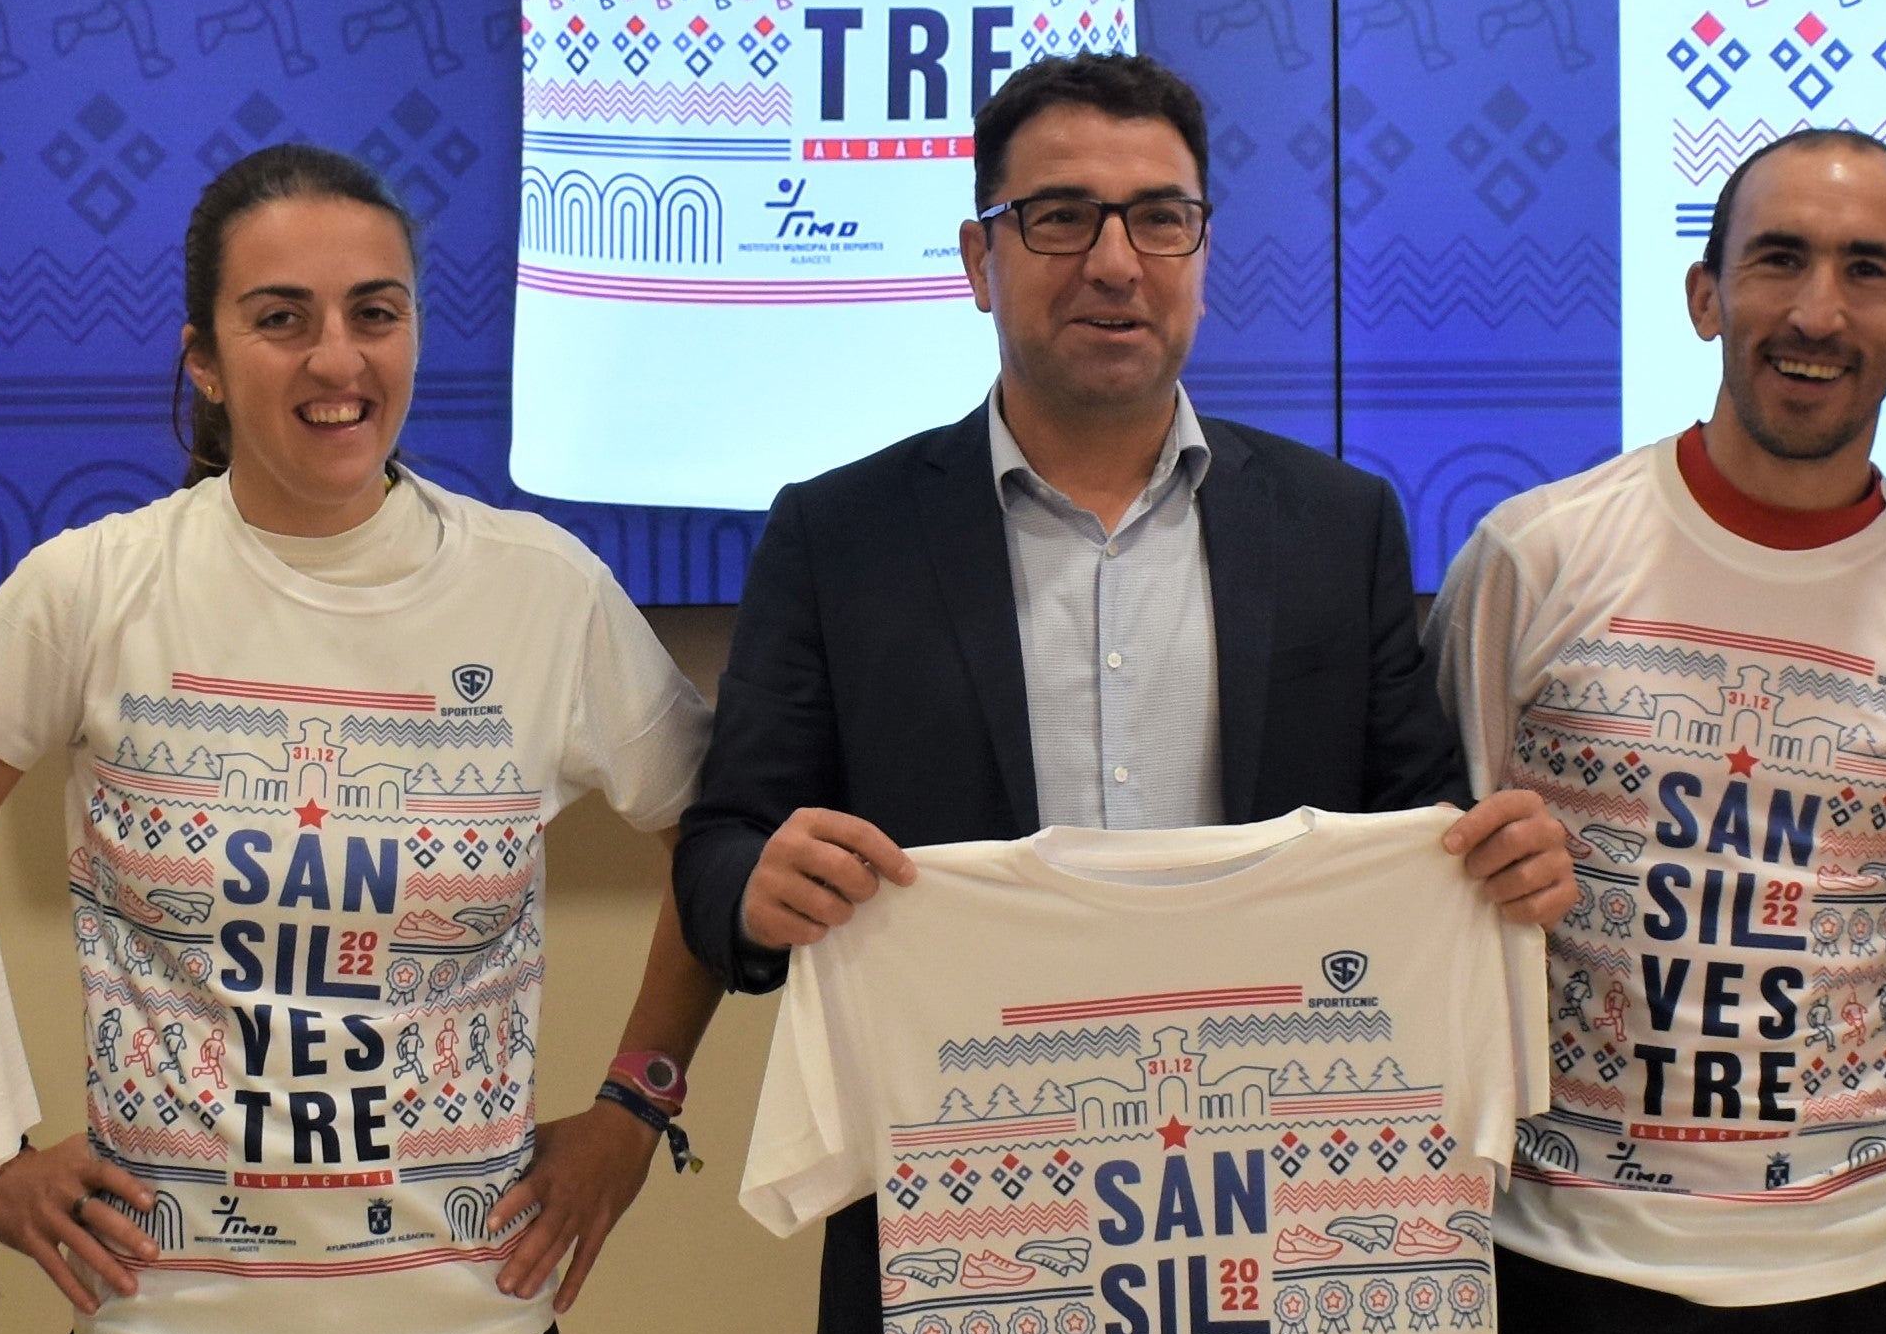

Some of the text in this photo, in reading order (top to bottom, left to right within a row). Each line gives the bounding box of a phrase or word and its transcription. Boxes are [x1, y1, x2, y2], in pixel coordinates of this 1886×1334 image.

[805, 5, 1013, 123] TRE
[814, 140, 957, 158] ALBACE
[440, 705, 503, 717] SPORTECNIC
[1727, 690, 1771, 711] 31.12
[293, 745, 335, 763] 31.12
[1655, 771, 1822, 867] SAN
[223, 828, 399, 914] SAN
[1764, 880, 1803, 902] 20
[1643, 863, 1807, 952] SIL
[1762, 904, 1799, 927] 22
[339, 930, 378, 952] 20
[219, 919, 381, 1000] SIL
[337, 954, 374, 976] 22
[1308, 996, 1379, 1008] SPORTECNIC
[1641, 953, 1805, 1041] VES
[235, 1004, 385, 1076] VES
[1148, 1058, 1193, 1075] 31.12
[1634, 1044, 1796, 1122] TRE
[234, 1084, 391, 1164] TRE
[242, 1173, 386, 1186] ALBACETE
[1092, 1149, 1267, 1247] SAN
[325, 1238, 386, 1252] AYUNTAMIENTO
[387, 1236, 397, 1244] DE
[1219, 1258, 1259, 1284] 20
[1221, 1286, 1259, 1311] 22
